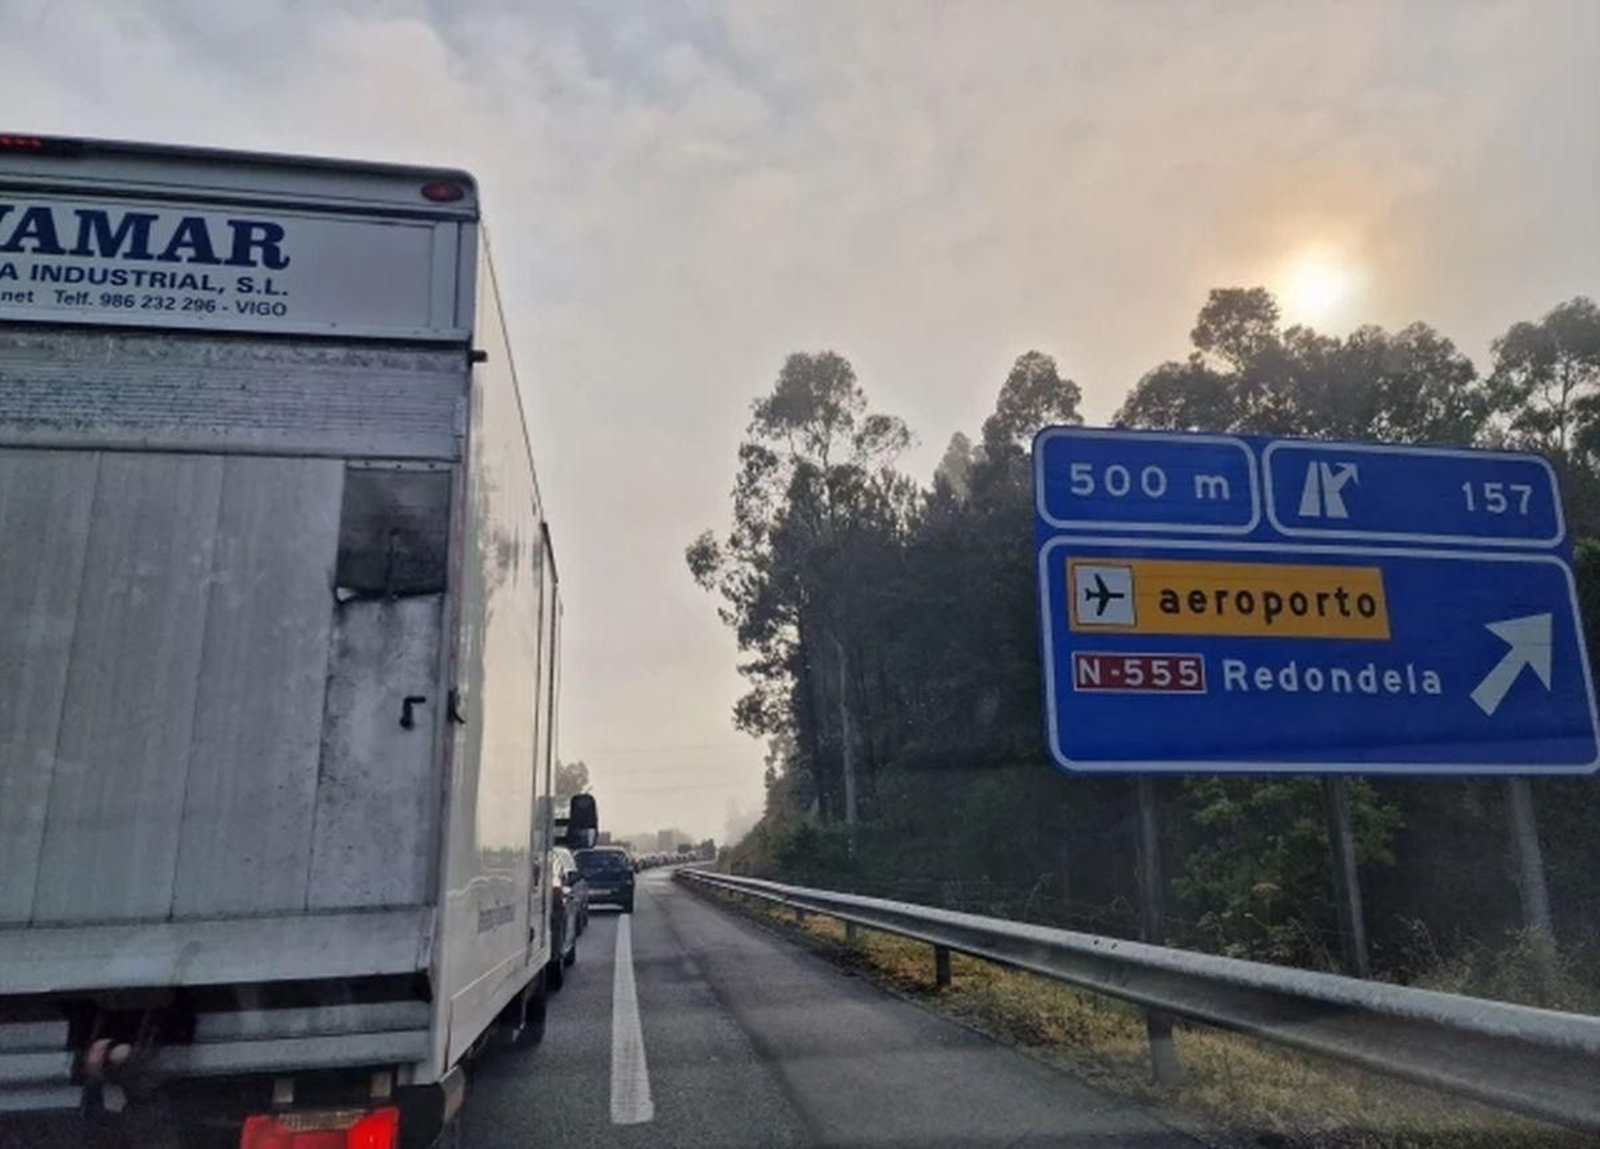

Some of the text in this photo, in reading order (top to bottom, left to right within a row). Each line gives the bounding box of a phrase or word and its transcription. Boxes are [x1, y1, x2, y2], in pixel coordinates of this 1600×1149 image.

[30, 264, 225, 294] INDUSTRIAL,
[236, 276, 288, 296] S.L.
[53, 289, 93, 306] Telf.
[100, 293, 136, 309] 986
[141, 295, 176, 311] 232
[181, 298, 216, 314] 296
[236, 301, 287, 317] VIGO
[1070, 463, 1230, 500] 500 m
[1462, 481, 1533, 515] 157
[1159, 586, 1377, 626] aeroporto
[1078, 658, 1443, 694] N-555 Redondela
